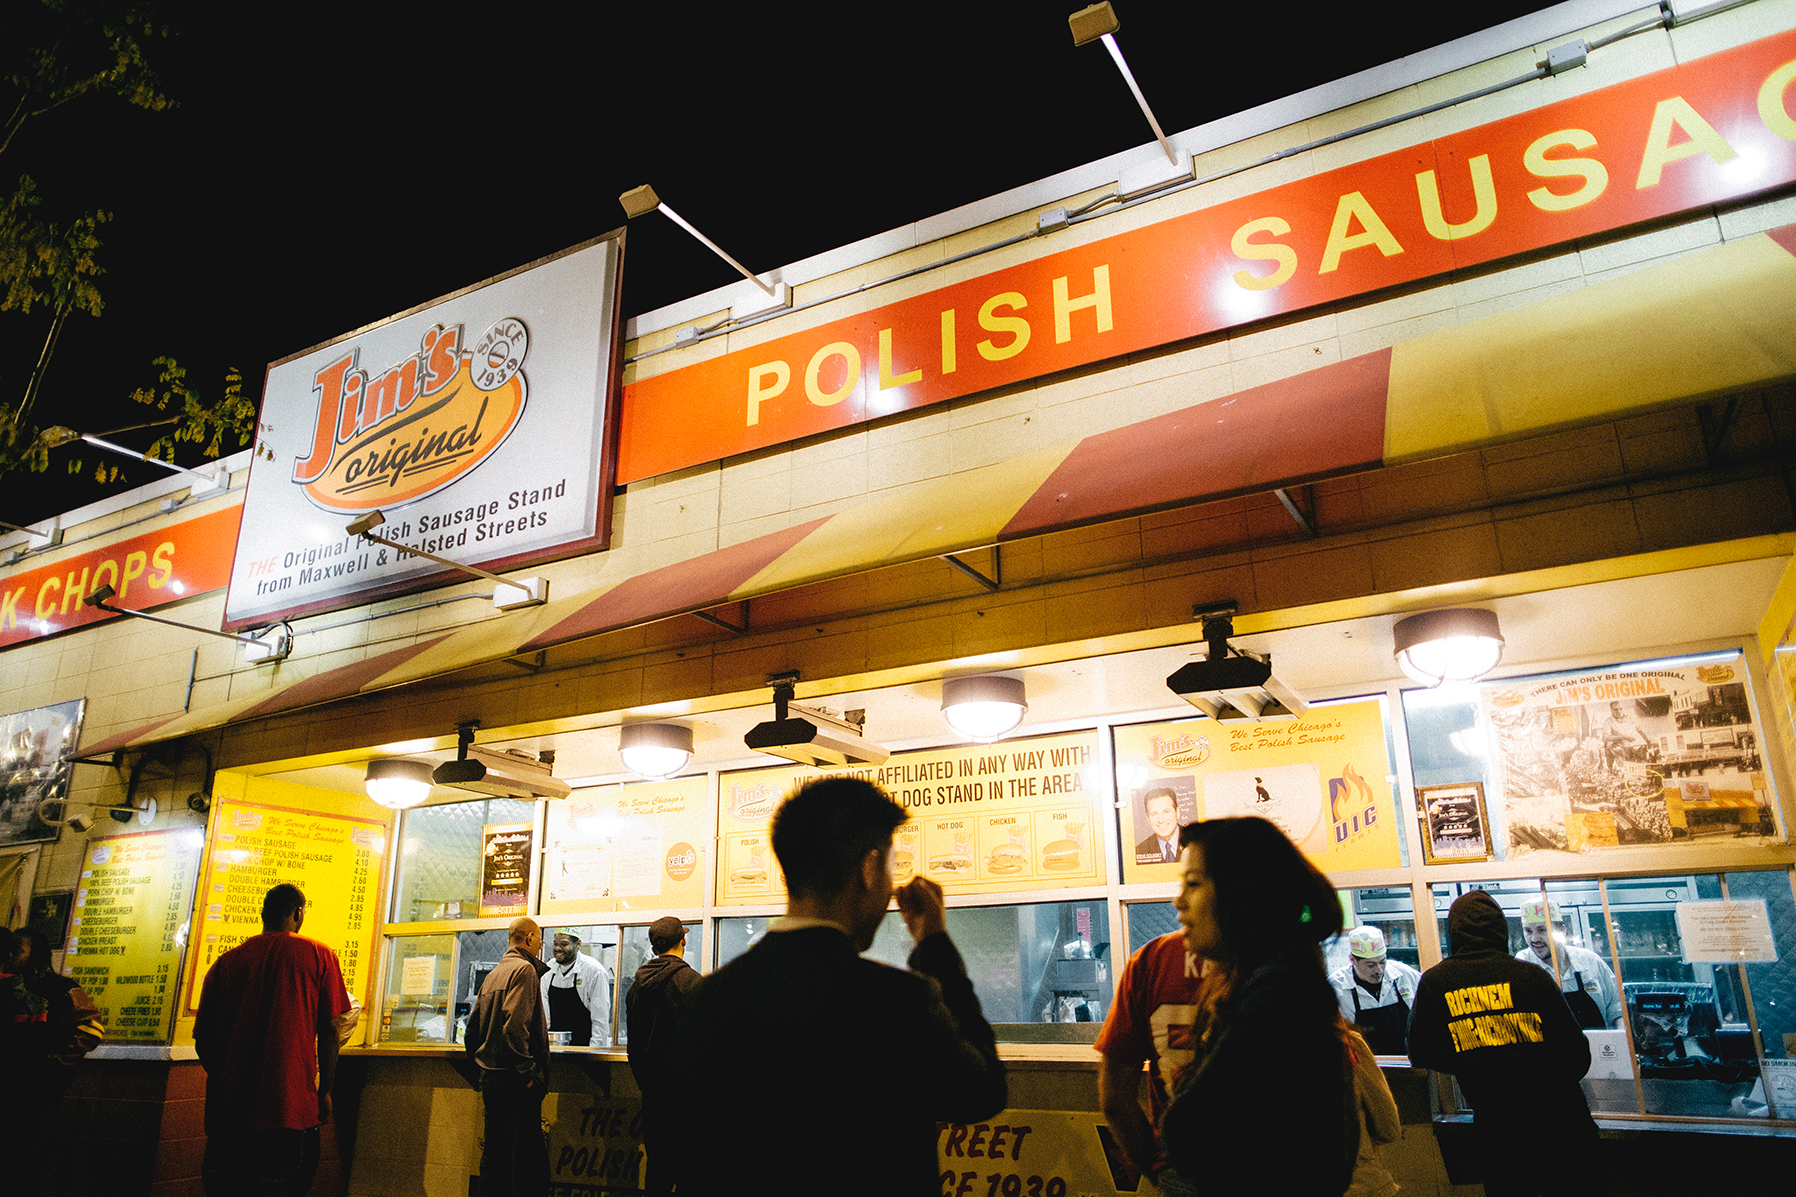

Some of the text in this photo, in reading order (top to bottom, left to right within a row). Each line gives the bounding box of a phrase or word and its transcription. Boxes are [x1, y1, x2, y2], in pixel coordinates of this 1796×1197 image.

[478, 323, 524, 356] SINCE
[746, 264, 1114, 427] POLISH
[477, 358, 518, 387] 1939
[293, 324, 463, 483] Jim's
[345, 396, 489, 487] original
[248, 556, 279, 579] THE
[283, 535, 350, 568] Original
[418, 500, 499, 533] Sausage
[507, 478, 566, 511] Stand
[256, 511, 549, 596] from Maxwell & Halsted Streets
[35, 541, 175, 621] CHOPS
[1530, 671, 1686, 698] THERE CAN ONLY BE ONE ORIGINAL
[1554, 678, 1666, 706] JIM'S ORIGINAL
[1230, 718, 1342, 739] We Serve Chicago's
[1149, 733, 1193, 762] Jim's
[1230, 732, 1347, 752] Best Polish Sausage
[1164, 750, 1202, 767] original
[877, 744, 1091, 786] AFFILIATED IN ANY WAY WITH
[902, 787, 932, 808] DOG
[937, 783, 983, 805] STAND
[989, 780, 1003, 800] IN
[1008, 777, 1037, 798] THE
[1042, 772, 1083, 795] AREA
[726, 782, 766, 812] Jim's
[740, 801, 775, 817] original
[989, 816, 1017, 826] CHICKEN
[1052, 813, 1067, 821] FISH
[268, 816, 344, 834] We Serve Chicago's
[937, 821, 963, 830] HOT DOG
[1334, 804, 1377, 844] UIC
[265, 827, 344, 845] Best Polish Sausage
[235, 835, 297, 850] POLISH SAUSAGE
[741, 839, 760, 847] POLISH
[254, 846, 333, 863] BEEF POLISH SAUSAGE
[356, 850, 370, 858] 3.80
[255, 856, 275, 867] CHOP
[287, 861, 306, 870] BONE
[355, 859, 369, 867] 4.10
[668, 854, 686, 867] yelp
[92, 869, 108, 877] POLISH
[230, 865, 278, 877] HAMBURGER
[354, 868, 368, 876] 4.25
[229, 875, 259, 886] DOUBLE
[353, 876, 367, 885] 2.60
[352, 885, 366, 893] 4.50
[85, 897, 115, 906] HAMBURGER
[225, 894, 256, 905] DOUBLE
[351, 894, 364, 903] 2.85
[84, 906, 133, 916] DOUBLE HAMBURGER
[224, 904, 257, 914] CHICKEN
[349, 903, 363, 912] 4.85
[82, 916, 118, 926] CHEESEBURGER
[232, 915, 259, 924] VIENNA
[348, 912, 362, 921] 4.95
[80, 926, 136, 936] DOUBLE CHEESEBURGER
[347, 921, 361, 930] 2.85
[78, 937, 97, 945] CHICKEN
[219, 935, 237, 944] FISH
[345, 940, 359, 948] 3.15
[81, 947, 98, 955] VIENNA
[344, 949, 358, 957] 1.50
[157, 964, 169, 973] 3.15
[343, 959, 357, 967] 1.80
[342, 968, 355, 976] 2.15
[1444, 982, 1513, 1017] RICHNEM
[579, 1107, 628, 1138] THE
[556, 1145, 644, 1181] POLISH
